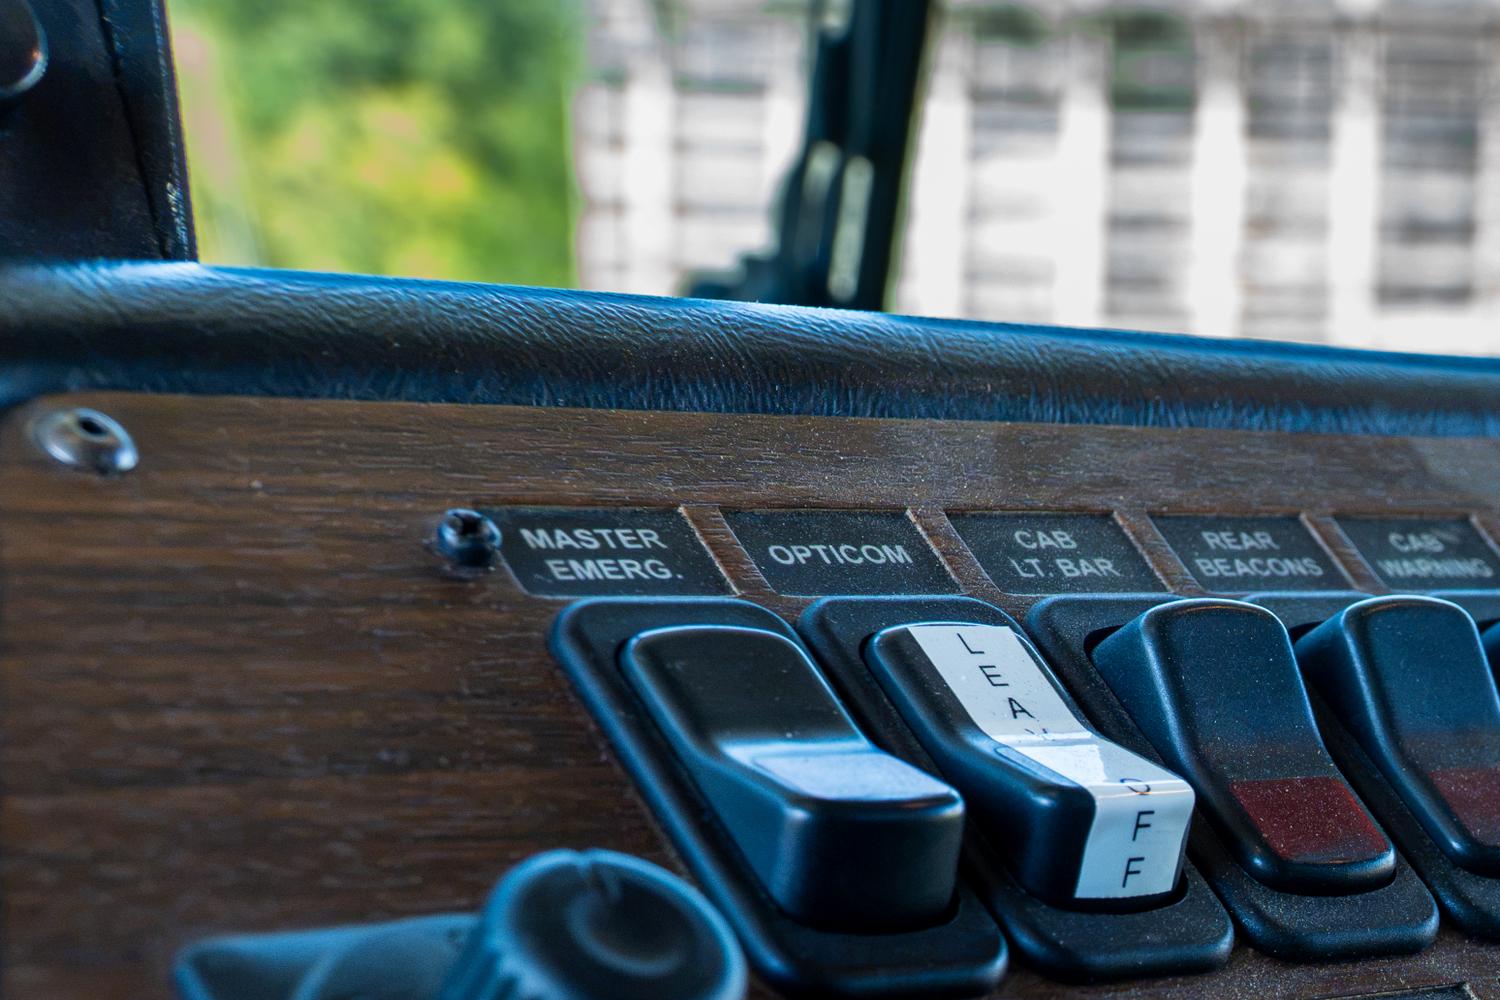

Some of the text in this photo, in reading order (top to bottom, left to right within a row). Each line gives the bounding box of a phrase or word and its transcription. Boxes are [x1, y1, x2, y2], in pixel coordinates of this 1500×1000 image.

[519, 527, 668, 550] MASTER
[1012, 529, 1078, 550] CAB
[1201, 531, 1281, 553] REAR
[767, 544, 914, 567] OPTICOM
[545, 557, 684, 582] EMERG.
[1009, 557, 1122, 578] LT. BAR
[1195, 558, 1325, 580] BEACONS
[1376, 558, 1495, 579] WARNING
[957, 633, 1048, 734] LEA
